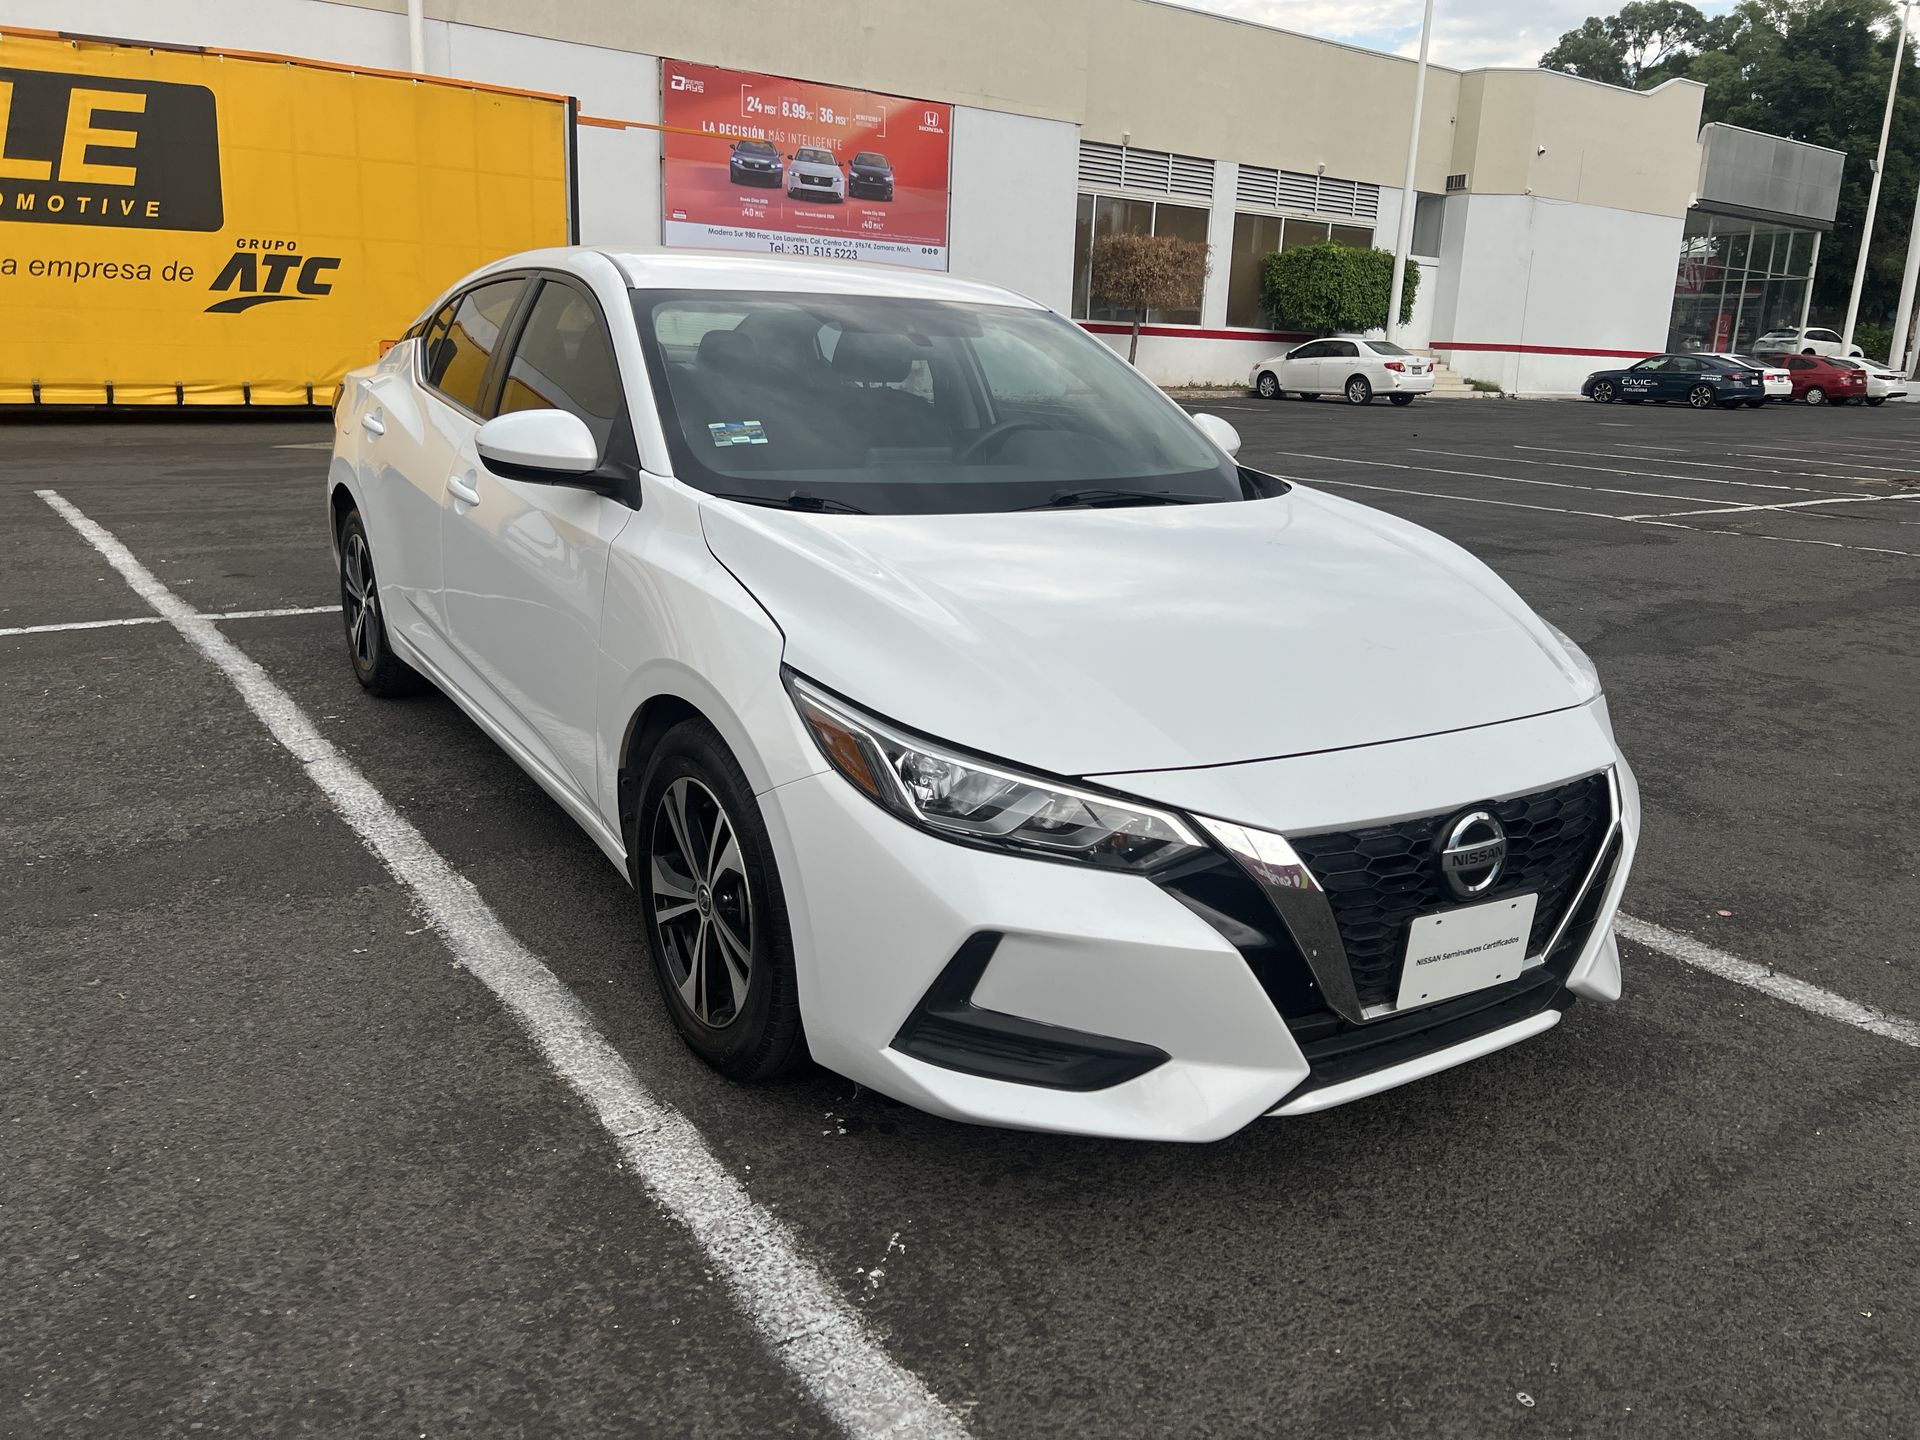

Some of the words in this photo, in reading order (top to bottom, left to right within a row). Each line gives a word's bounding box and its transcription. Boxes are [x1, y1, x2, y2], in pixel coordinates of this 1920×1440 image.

[747, 96, 762, 112] 24
[820, 107, 833, 124] 36
[0, 82, 147, 186] LE
[703, 121, 716, 133] LA
[719, 122, 765, 140] DECISIÓN
[768, 129, 785, 143] MÁS
[788, 134, 842, 150] INTELIGENTE
[919, 125, 944, 134] HONDA
[0, 192, 160, 217] MOTIVE
[236, 238, 297, 251] GRUPO
[708, 228, 733, 237] Madero
[757, 232, 771, 240] Frac.
[823, 239, 842, 247] Centro
[897, 245, 911, 253] Mich.
[793, 244, 810, 256] 351
[814, 246, 831, 258] 515
[835, 248, 858, 260] 5223
[1, 258, 17, 276] a
[29, 258, 151, 283] empresa
[162, 260, 195, 283] de
[208, 252, 341, 295] ATC
[1452, 846, 1504, 867] NISSAN
[1416, 954, 1442, 967] NISSAN
[1442, 945, 1482, 961] Seminuevos
[1482, 936, 1519, 951] Certificados
